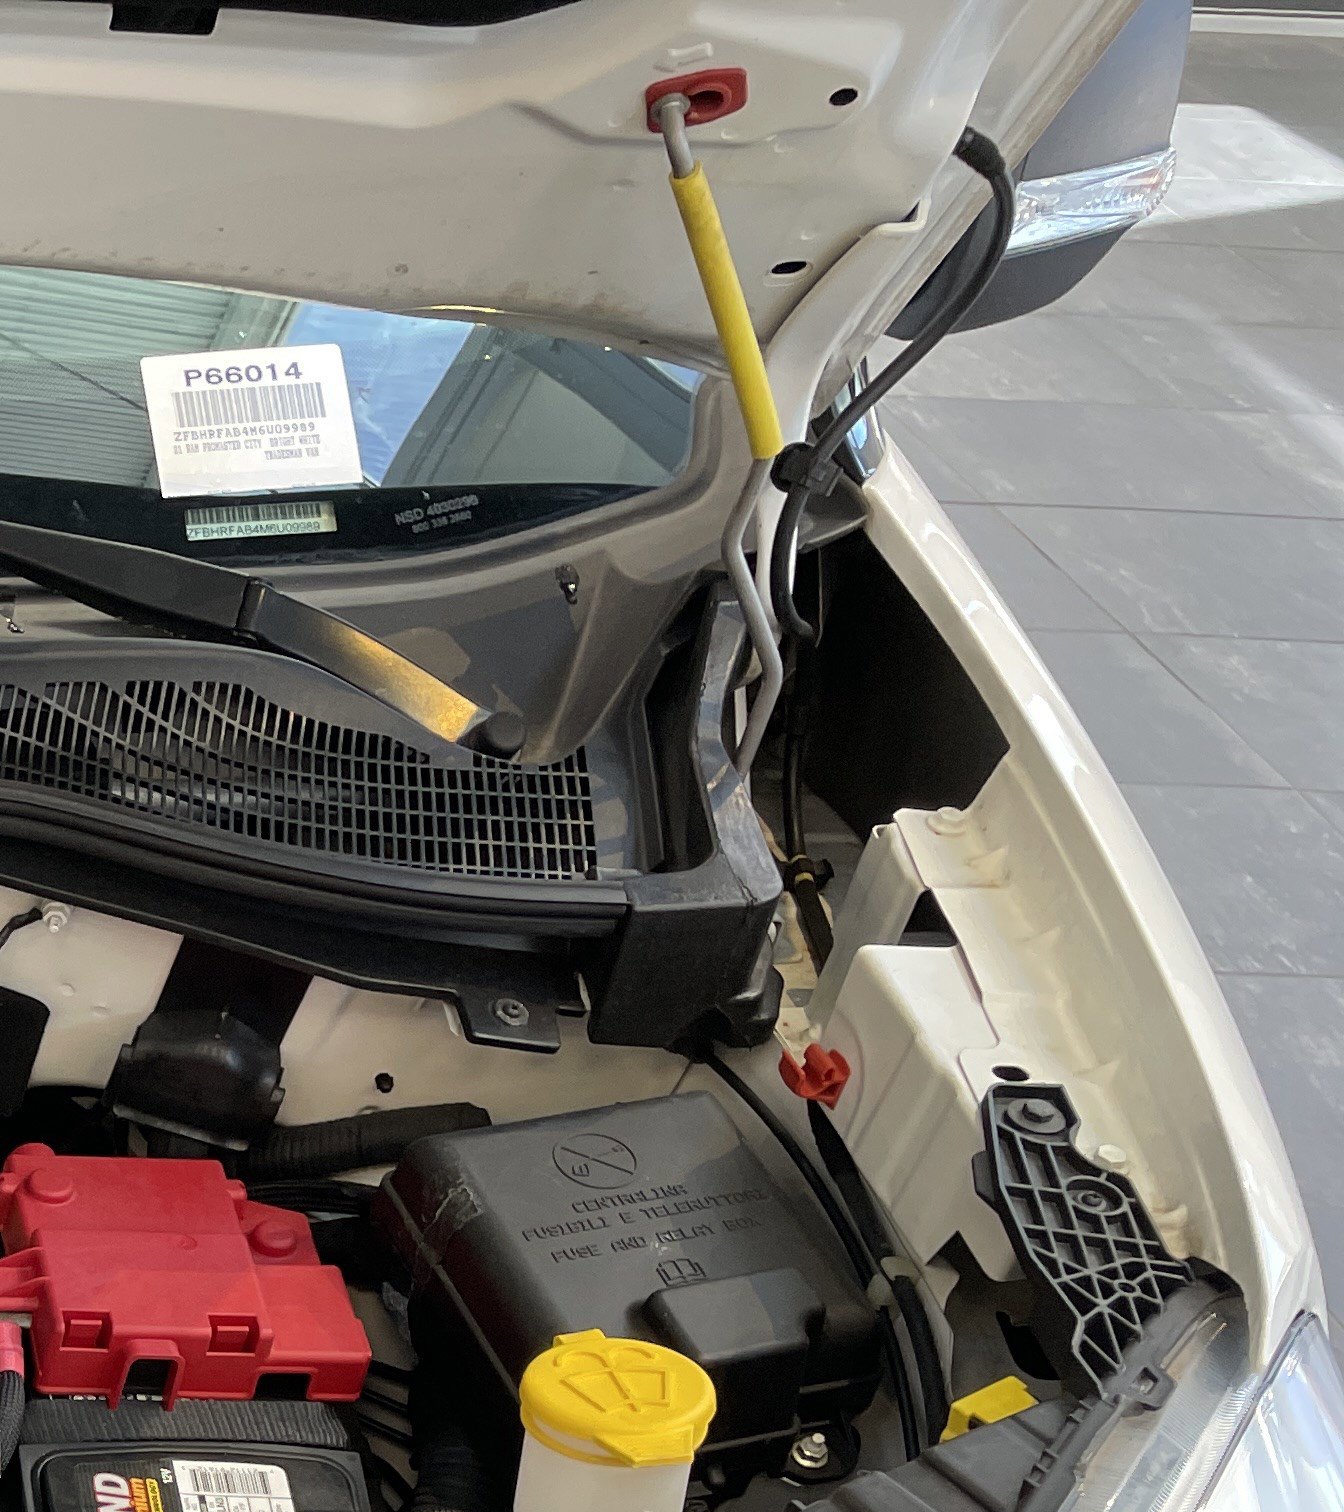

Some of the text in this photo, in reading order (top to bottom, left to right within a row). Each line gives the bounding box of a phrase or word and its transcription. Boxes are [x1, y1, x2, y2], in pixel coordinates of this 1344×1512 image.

[184, 361, 303, 387] P66014
[244, 439, 262, 449] CITY
[551, 1243, 601, 1264] FUSE
[610, 1235, 647, 1252] AND
[723, 1215, 762, 1237] BOX
[161, 1468, 172, 1484] 12V
